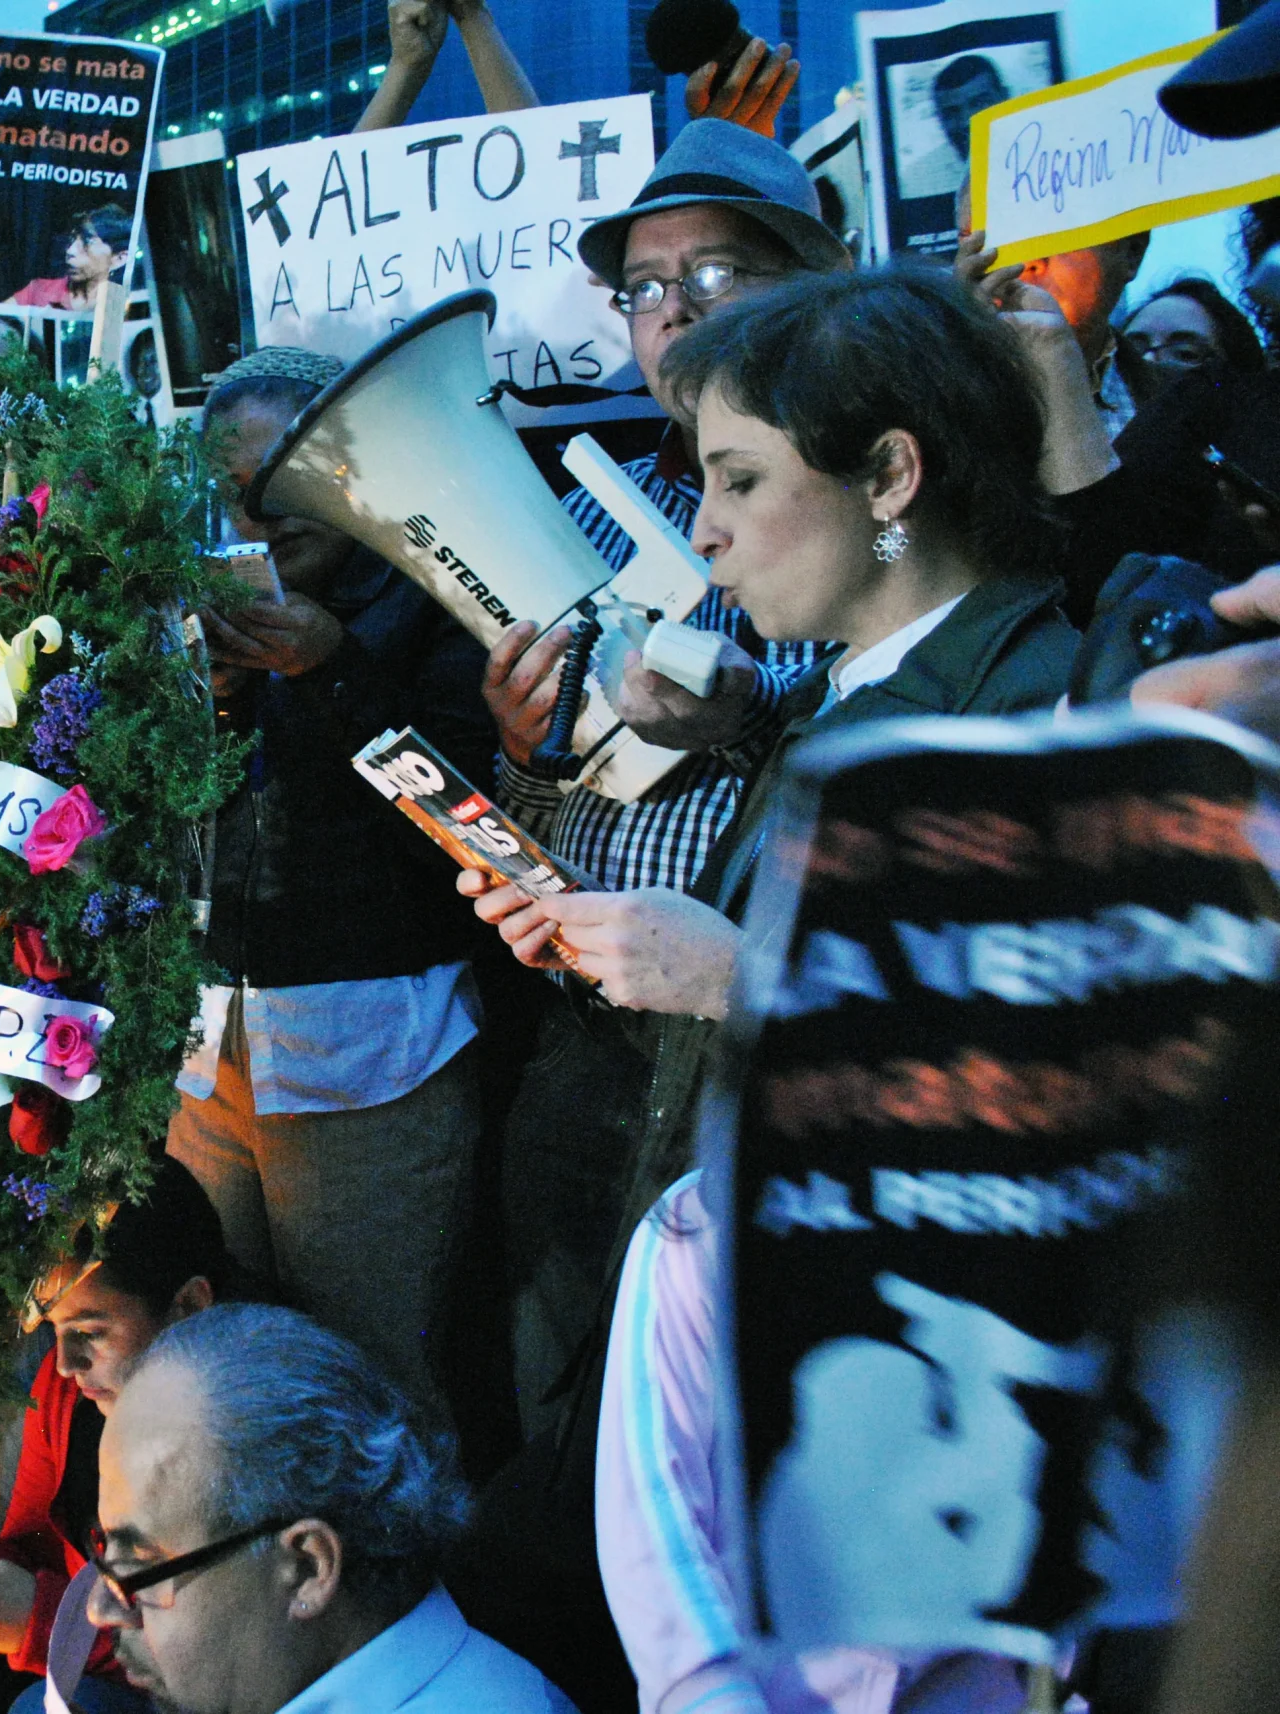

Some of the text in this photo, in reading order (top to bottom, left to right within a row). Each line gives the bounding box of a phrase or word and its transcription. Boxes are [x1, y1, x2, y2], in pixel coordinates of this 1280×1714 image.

[32, 88, 141, 117] VERDAD
[38, 56, 67, 73] se
[75, 58, 146, 80] mata
[11, 161, 128, 190] PERIODISTA
[308, 125, 525, 240] ALTO
[1005, 121, 1115, 213] Regina
[269, 261, 300, 322] A
[327, 253, 404, 312] LAS
[434, 546, 518, 628] STEREN
